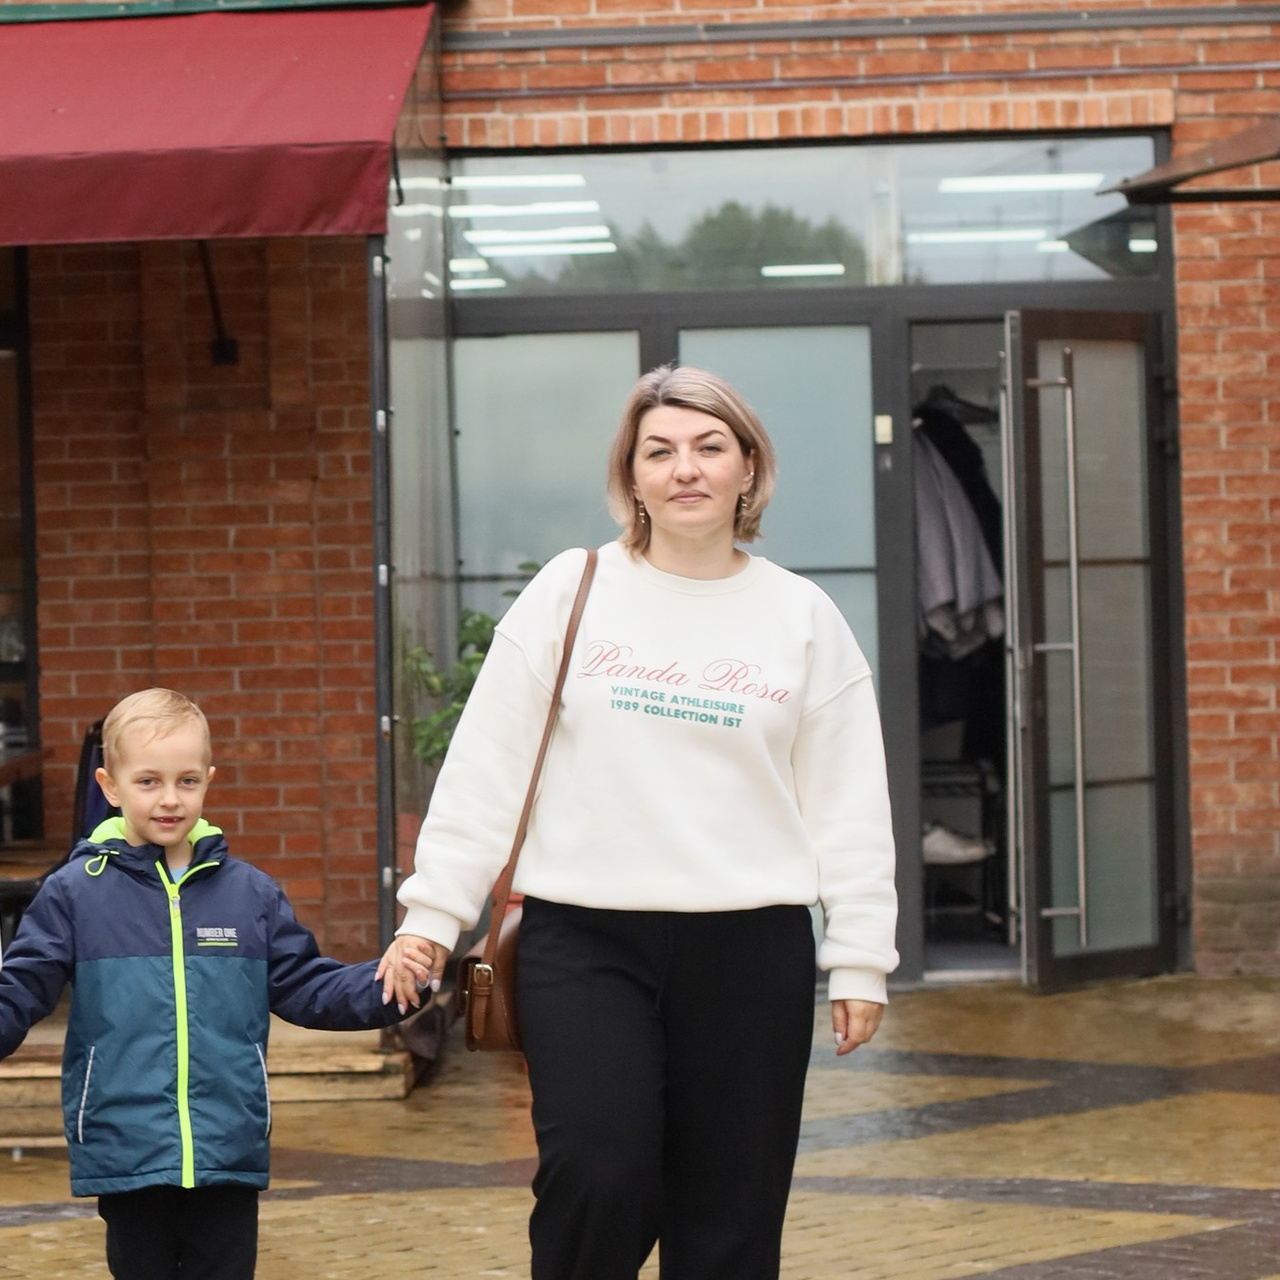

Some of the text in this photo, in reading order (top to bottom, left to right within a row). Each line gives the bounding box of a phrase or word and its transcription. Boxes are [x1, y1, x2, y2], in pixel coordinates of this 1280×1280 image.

[577, 639, 792, 704] Panda Rosa
[610, 685, 746, 715] VINTAGE ATHLEISURE
[610, 699, 639, 712] 1989
[643, 704, 719, 725] COLLECTION
